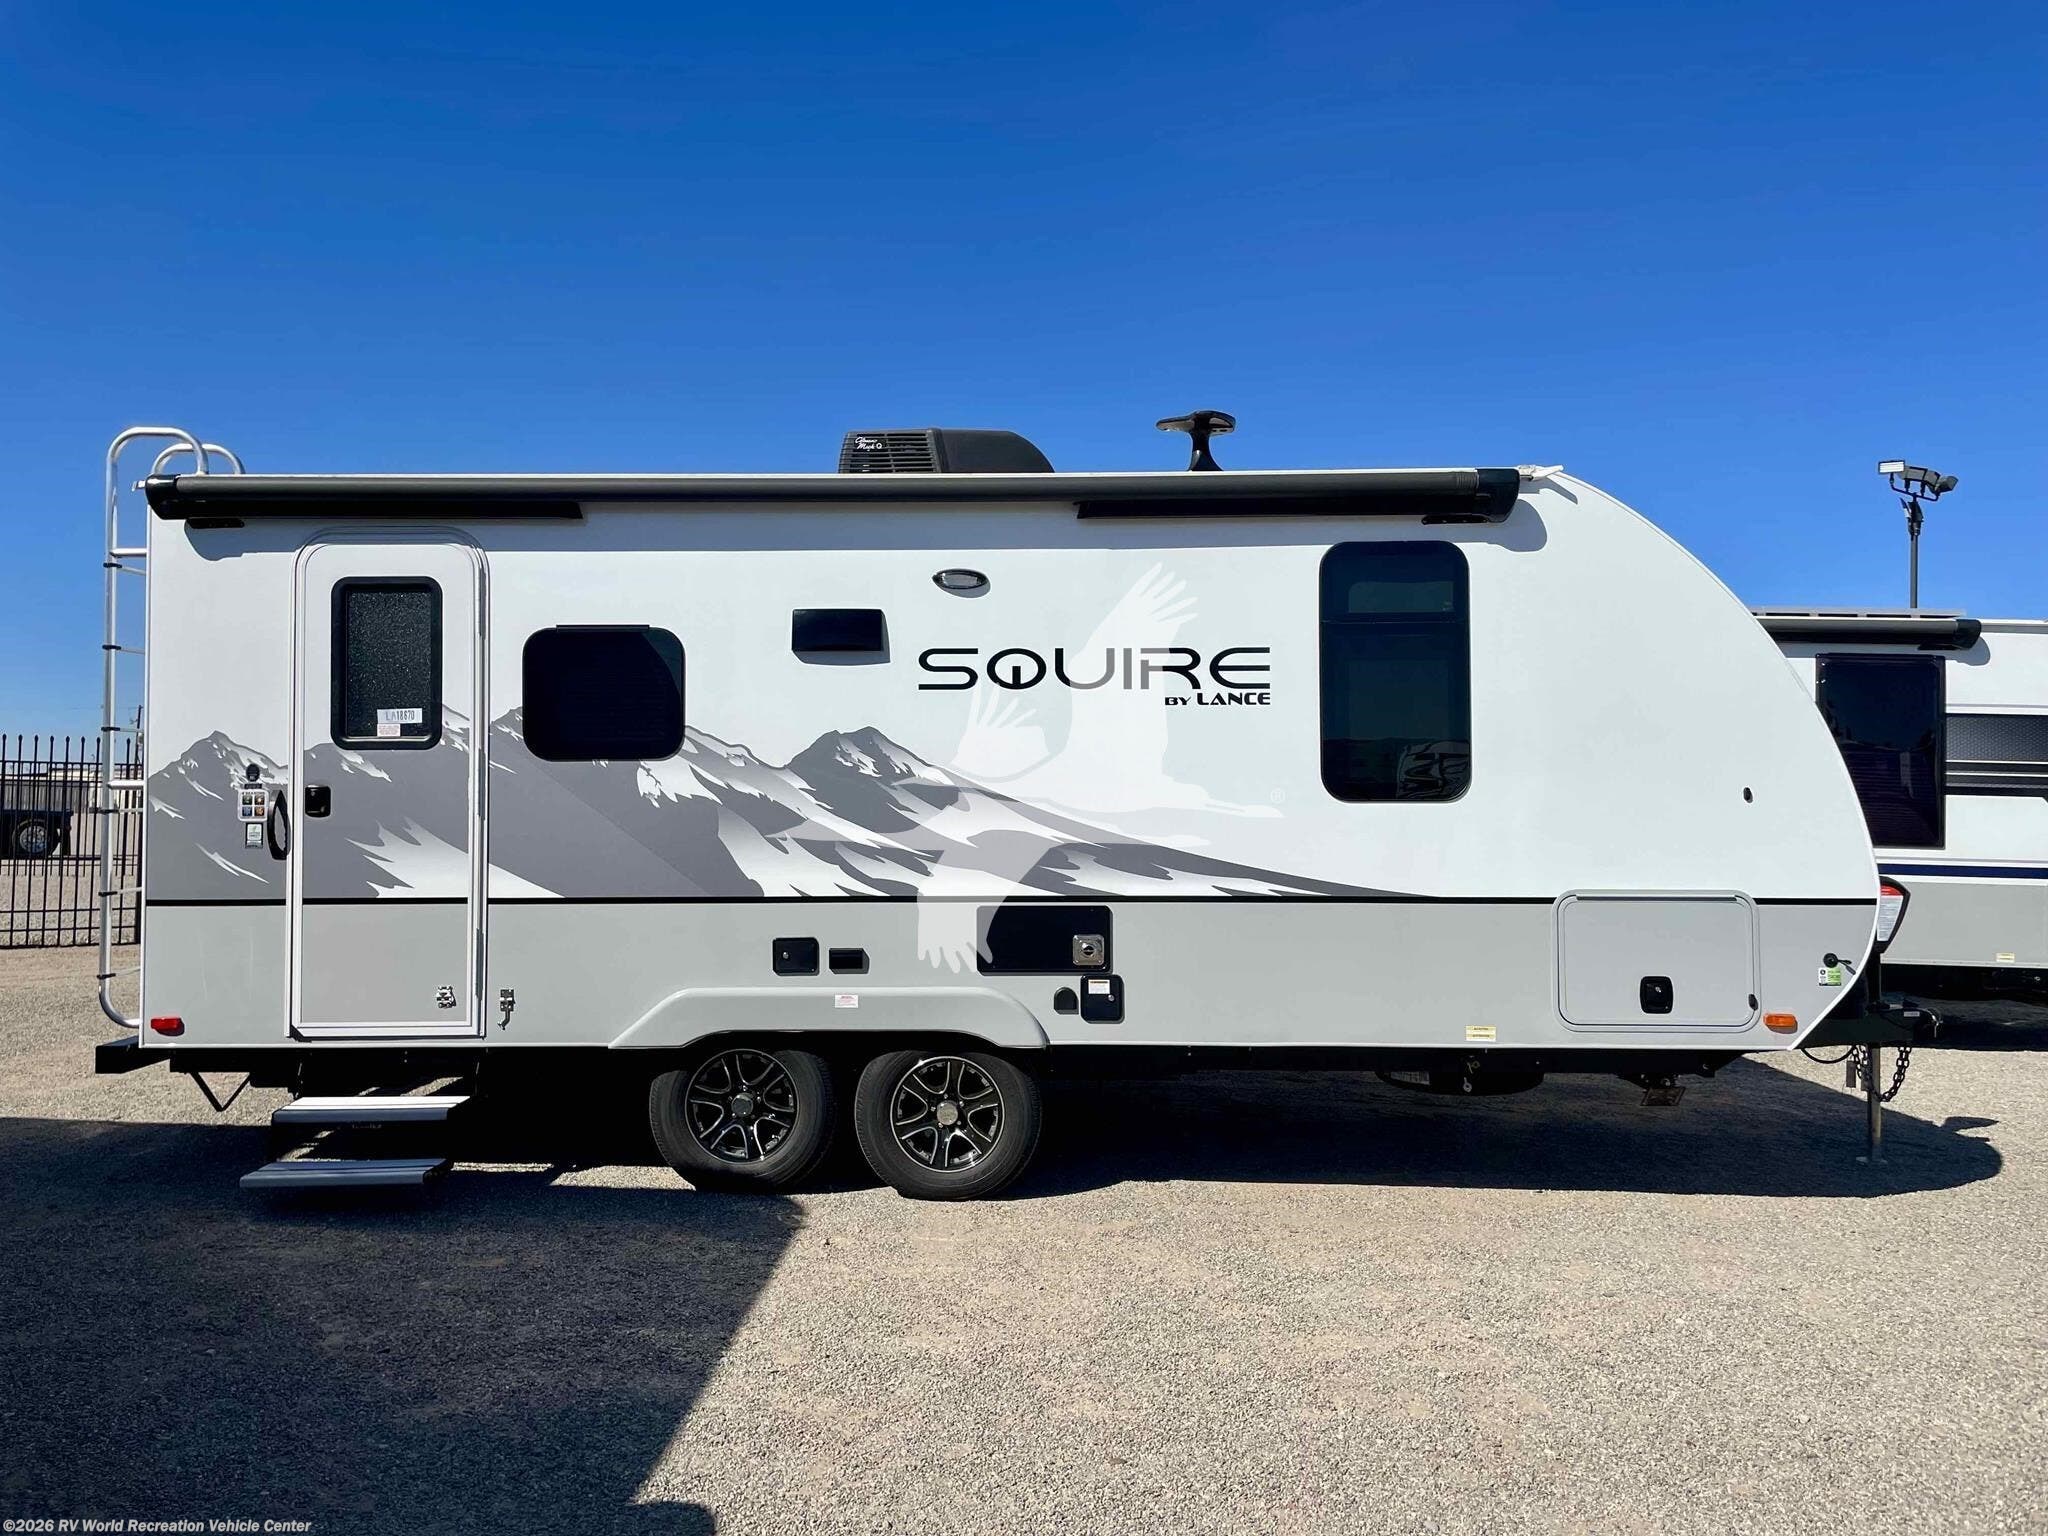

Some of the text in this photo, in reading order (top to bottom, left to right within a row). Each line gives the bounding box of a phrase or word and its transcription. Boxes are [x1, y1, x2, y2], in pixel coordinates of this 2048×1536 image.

[918, 646, 1271, 690] SQUIRE
[1164, 692, 1271, 706] BY LANCE
